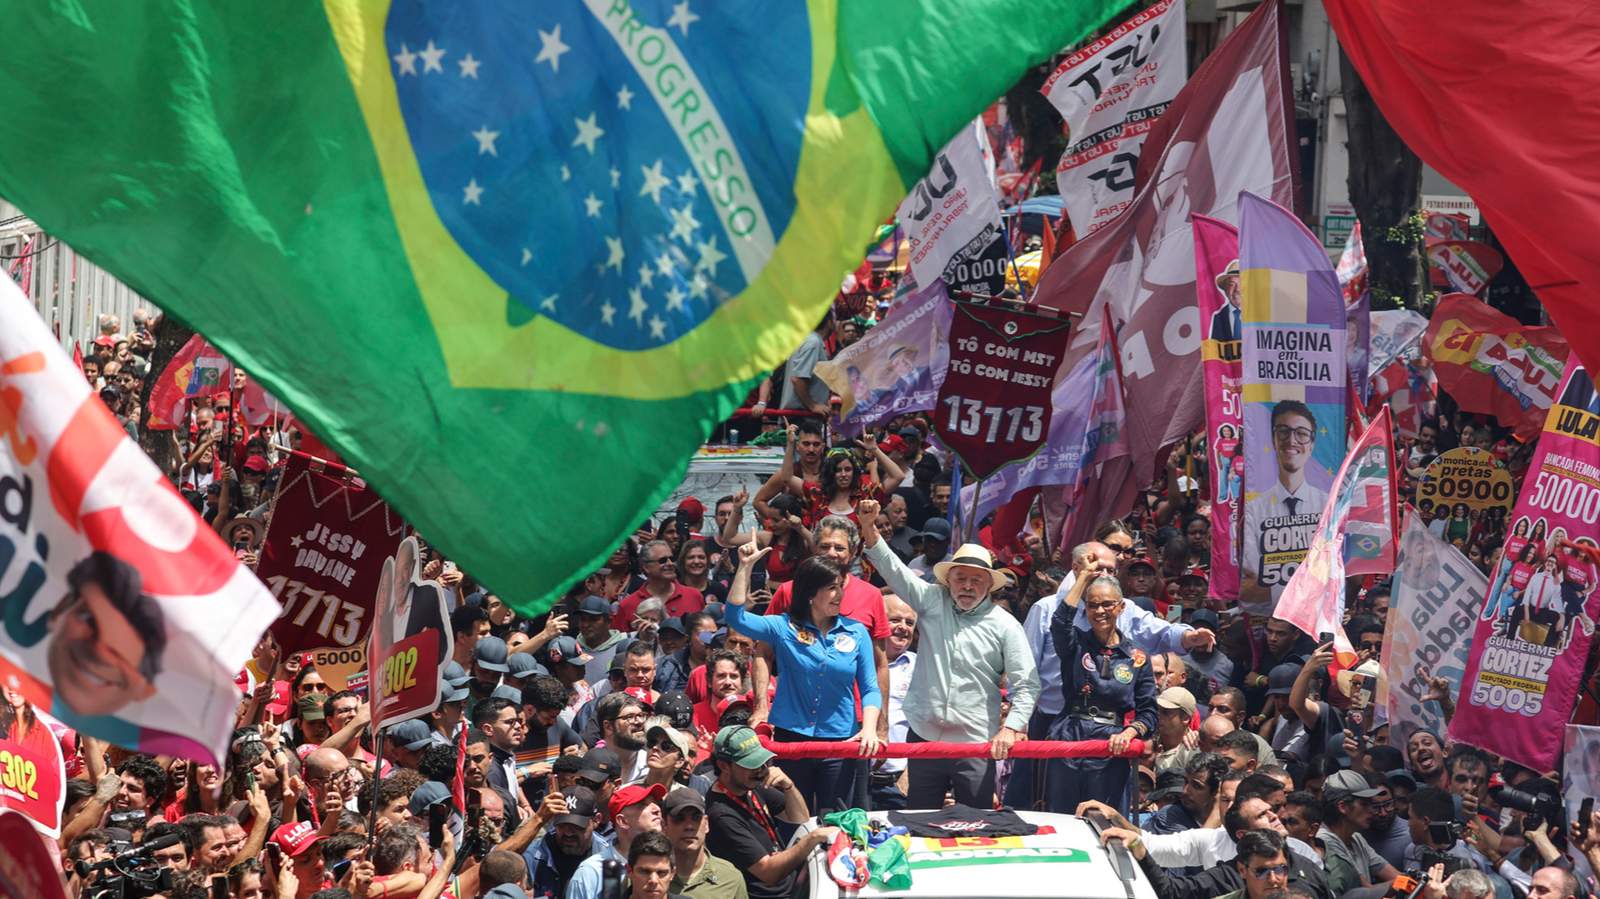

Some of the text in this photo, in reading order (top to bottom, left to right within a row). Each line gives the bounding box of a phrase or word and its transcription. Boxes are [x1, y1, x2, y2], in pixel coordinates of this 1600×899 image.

[606, 0, 757, 238] PROGRESSO
[957, 336, 1056, 368] TÔ COM MST
[1256, 330, 1332, 352] IMAGINA
[1278, 350, 1299, 361] em
[951, 358, 1053, 388] TÔ COM JESSY
[1258, 357, 1331, 382] BRASÍLIA
[944, 395, 1045, 444] 13713
[1556, 402, 1600, 439] LULA
[1440, 466, 1493, 478] pretas
[1421, 477, 1510, 501] 50900
[1529, 471, 1600, 525] 50000
[1264, 513, 1322, 528] GUILHERM
[305, 522, 366, 561] JESSY
[1263, 525, 1317, 552] CORTE
[1262, 562, 1302, 586] 50
[317, 650, 367, 666] 5000
[1488, 635, 1557, 657] GUILHERME
[377, 647, 417, 698] 302
[1482, 648, 1554, 682] CORTEZ
[1480, 673, 1543, 692] DEPUTADO FEDERAL
[1473, 683, 1544, 715] 5005
[0, 750, 39, 801] 302
[909, 848, 1074, 861] ADDAD
